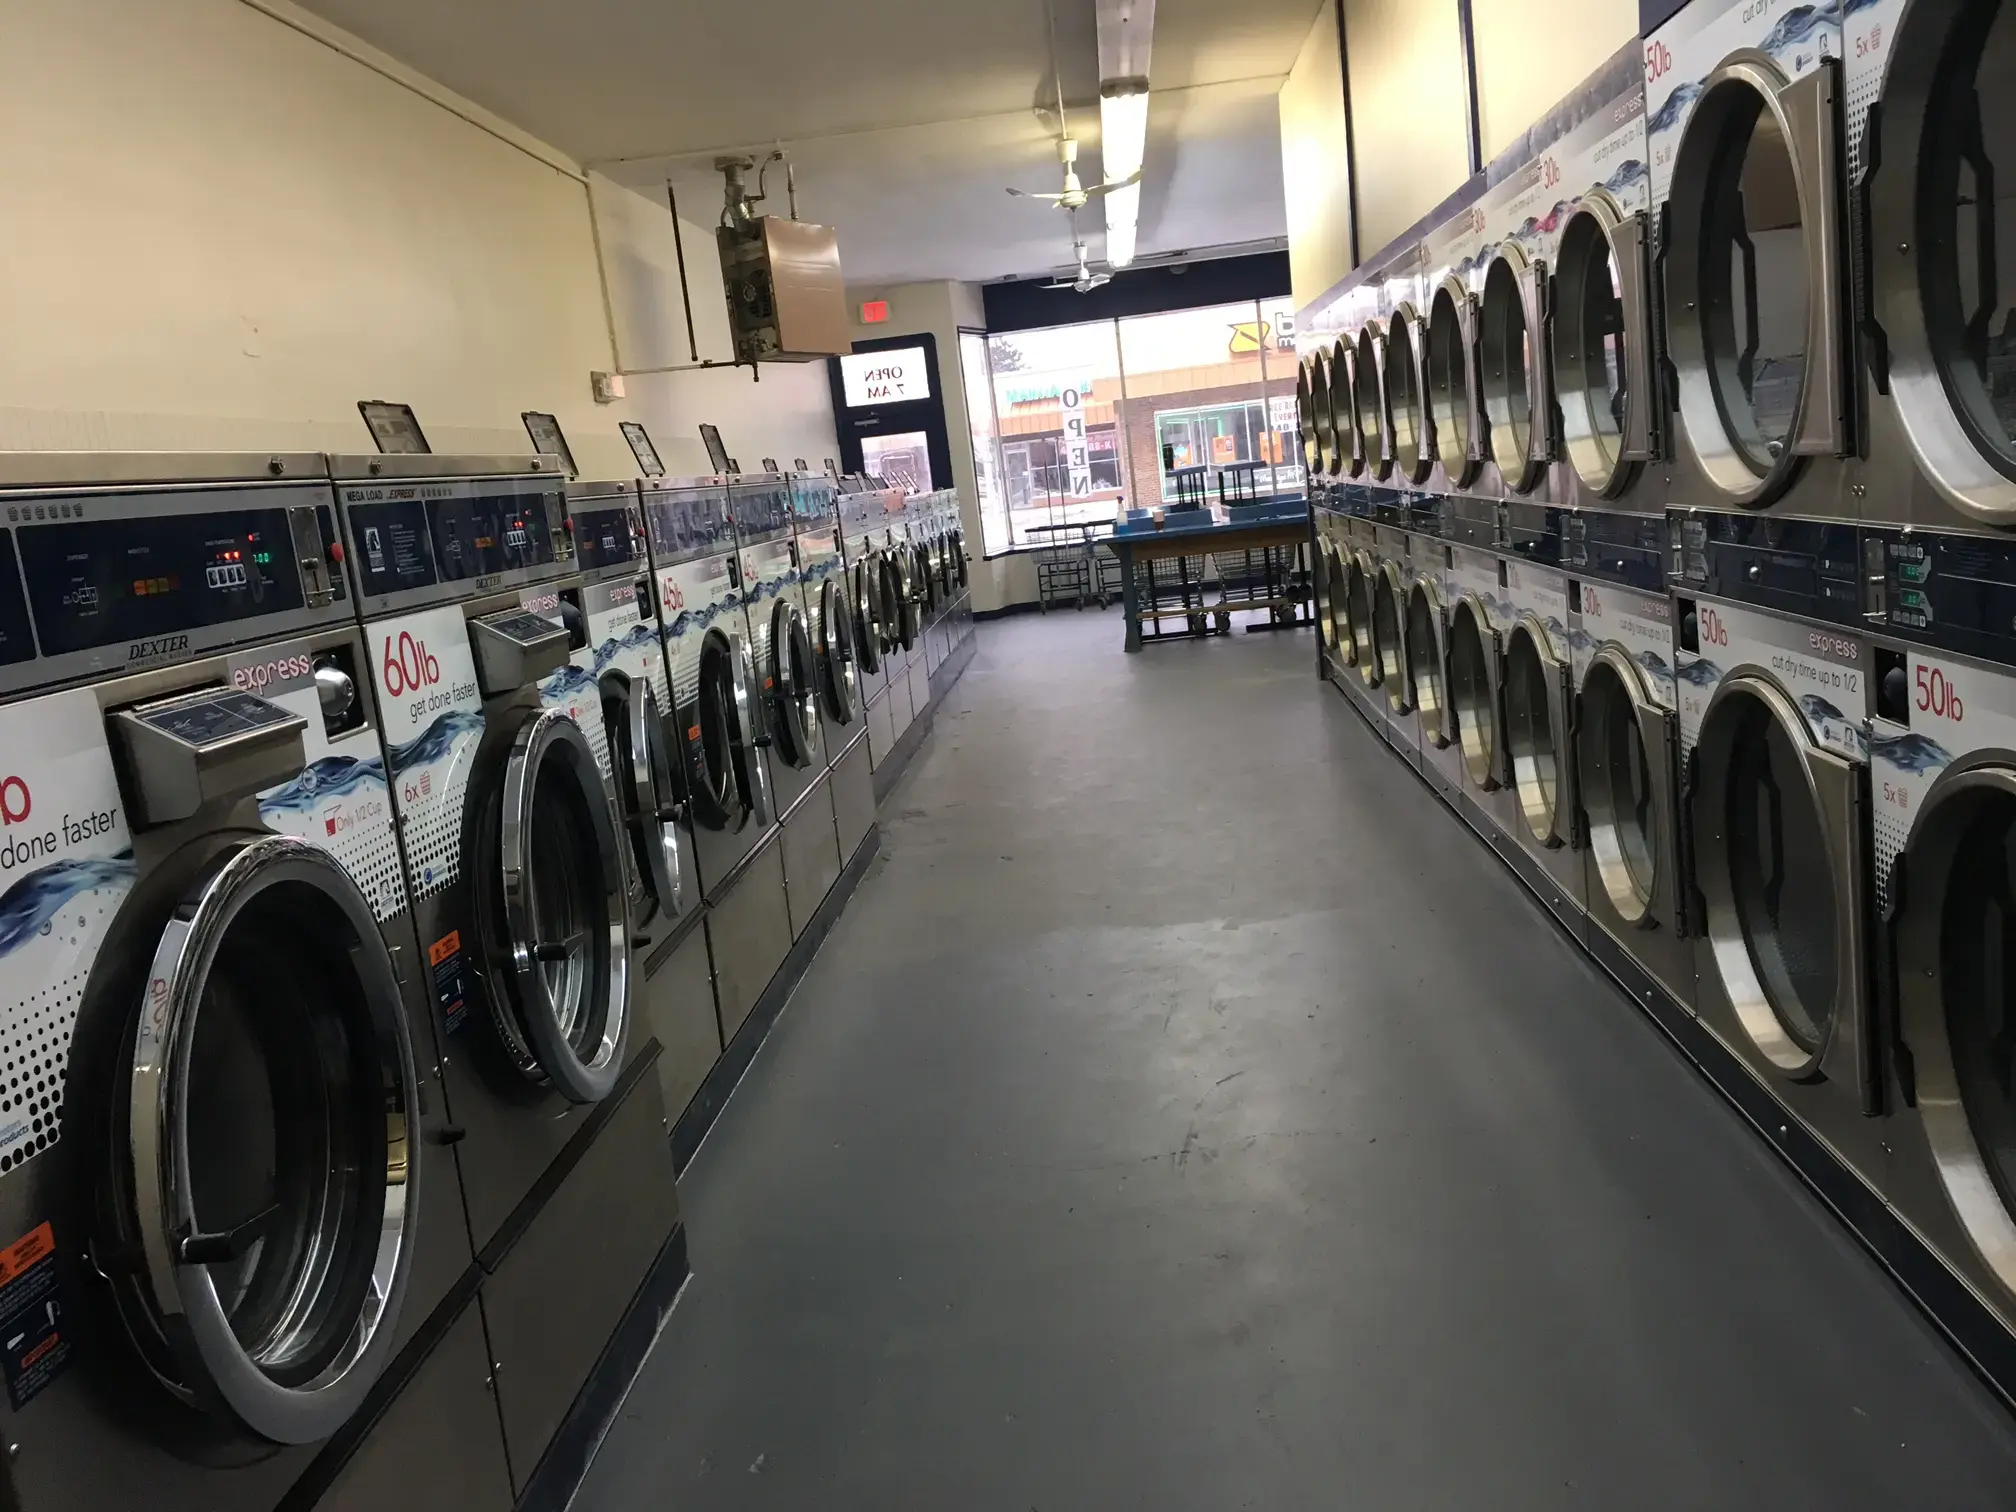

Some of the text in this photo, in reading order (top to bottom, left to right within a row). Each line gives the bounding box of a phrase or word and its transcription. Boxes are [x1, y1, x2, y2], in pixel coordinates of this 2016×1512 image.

[1647, 40, 1672, 83] 50lb
[1856, 36, 1868, 58] 5x
[346, 490, 364, 501] MEGA
[366, 490, 383, 501] LOAD
[475, 575, 502, 589] DEXTER
[663, 576, 684, 611] 45lb
[1701, 607, 1728, 647] 50lb
[128, 634, 189, 660] DEXTER
[1809, 632, 1858, 660] express
[233, 653, 311, 696] express
[384, 631, 440, 697] 60lb
[1771, 656, 1857, 693] cut dry time up to 1/2
[410, 682, 476, 723] get done faster
[1916, 664, 1963, 722] 50lb
[404, 782, 420, 803] 6x
[1883, 782, 1897, 804] 5x
[336, 813, 354, 829] Only
[0, 808, 117, 870] done faster
